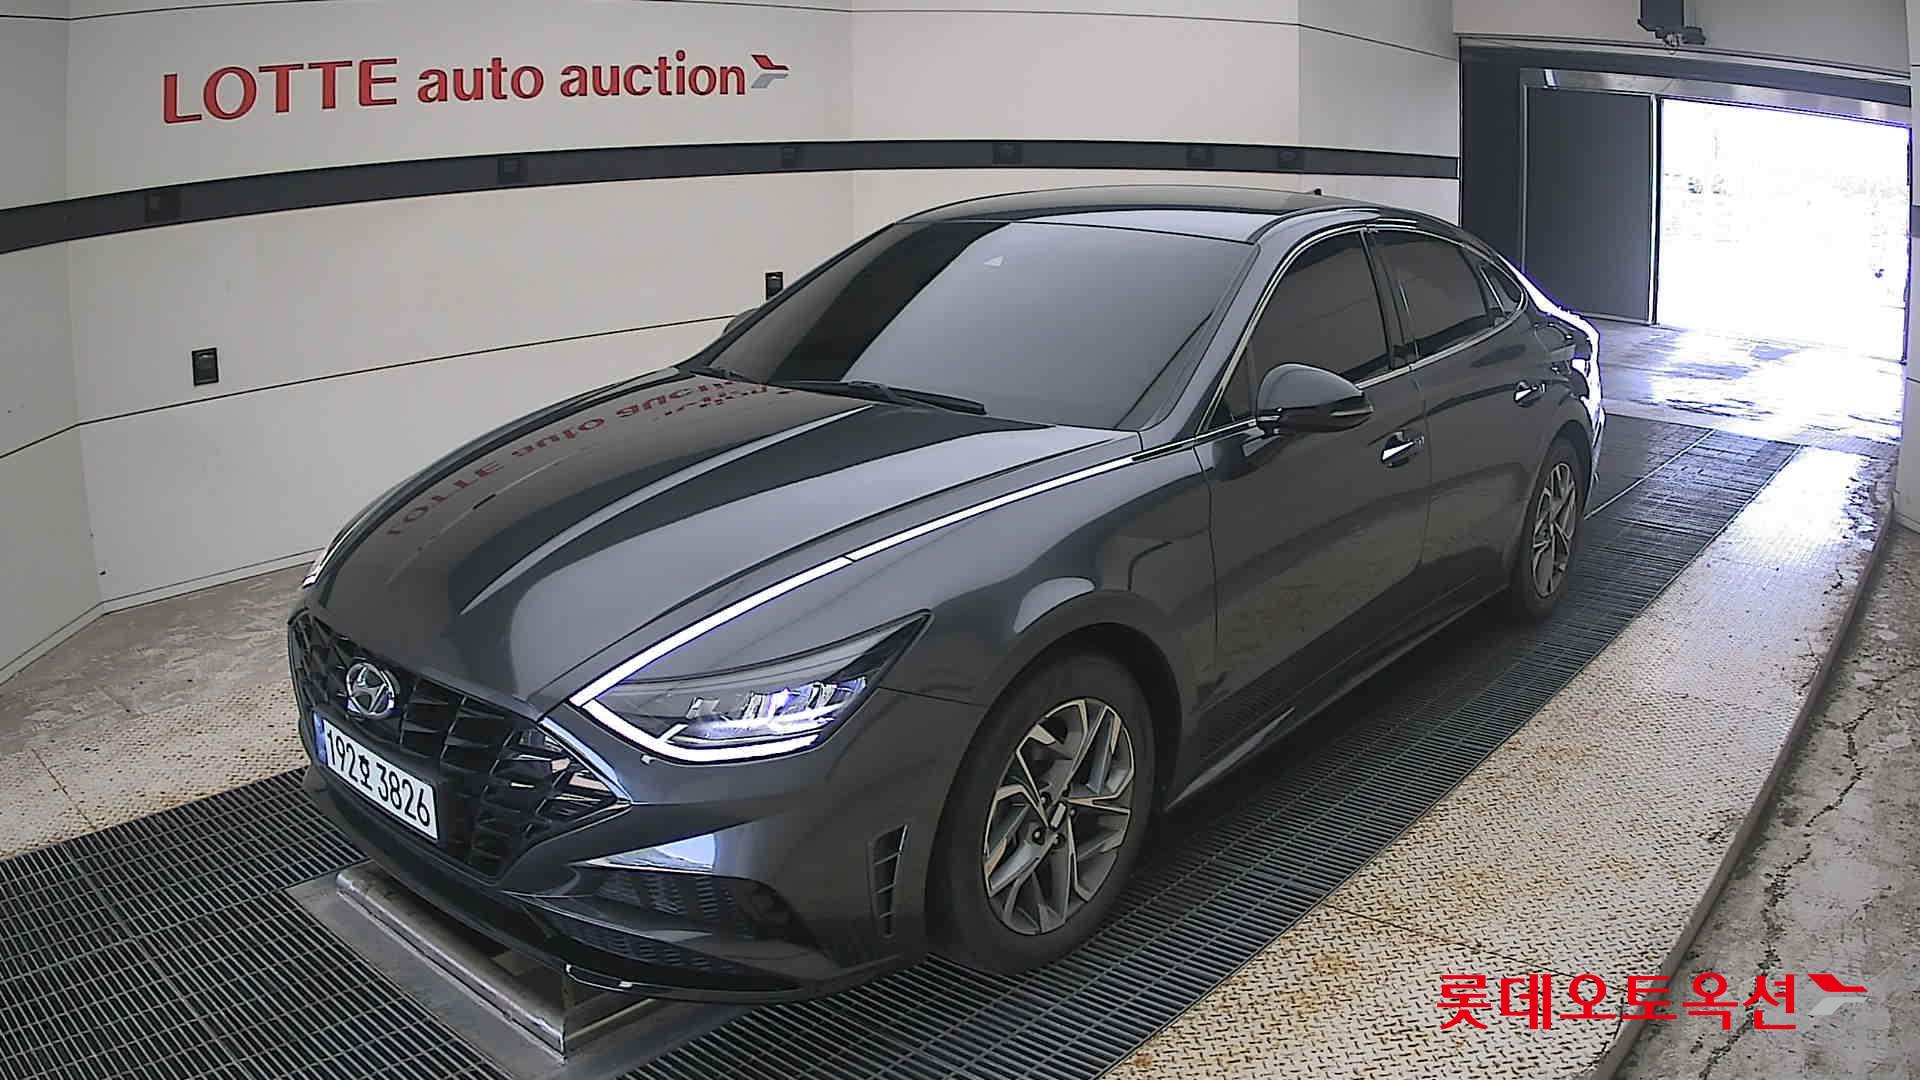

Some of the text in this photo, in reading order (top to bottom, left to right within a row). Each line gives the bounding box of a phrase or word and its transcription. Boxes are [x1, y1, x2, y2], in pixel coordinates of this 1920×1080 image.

[162, 51, 746, 124] LOTTE auto auction
[375, 762, 431, 828] 3826
